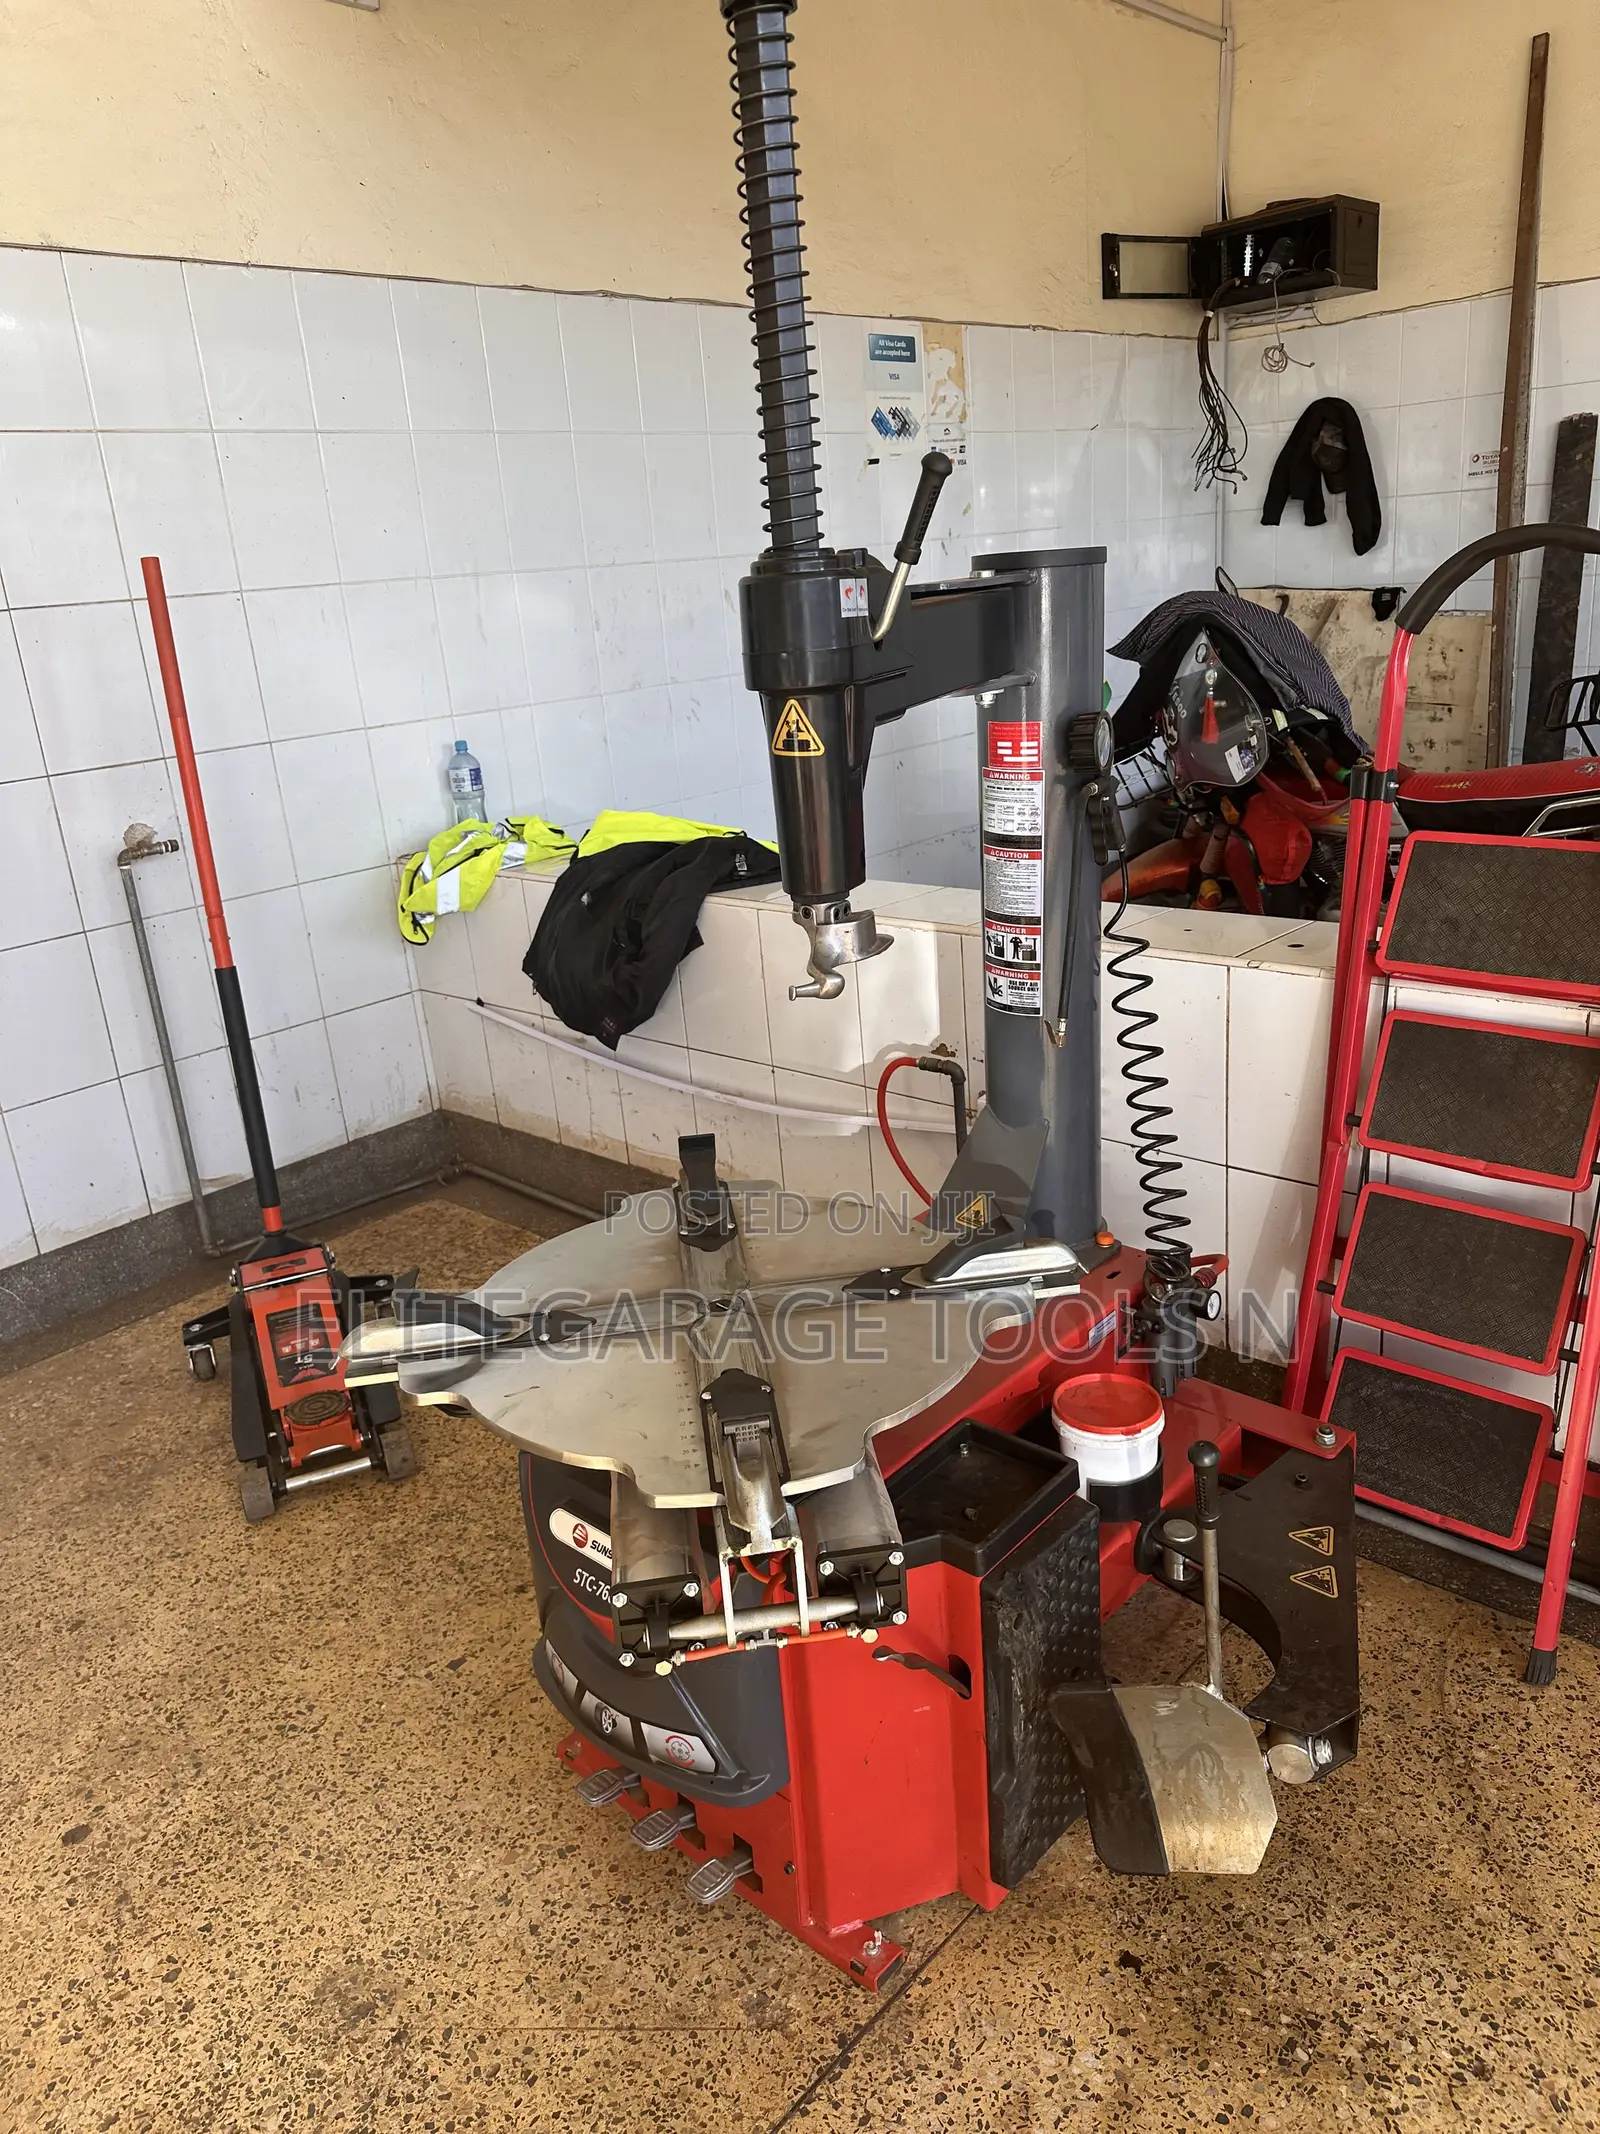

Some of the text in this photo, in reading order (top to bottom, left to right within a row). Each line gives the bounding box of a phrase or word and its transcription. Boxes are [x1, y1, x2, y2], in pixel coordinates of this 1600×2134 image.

[888, 372, 900, 380] VISA
[994, 772, 1030, 781] WARNING
[995, 850, 1029, 859] CAUTION
[996, 926, 1027, 935] DANGER
[995, 968, 1029, 979] WARNING
